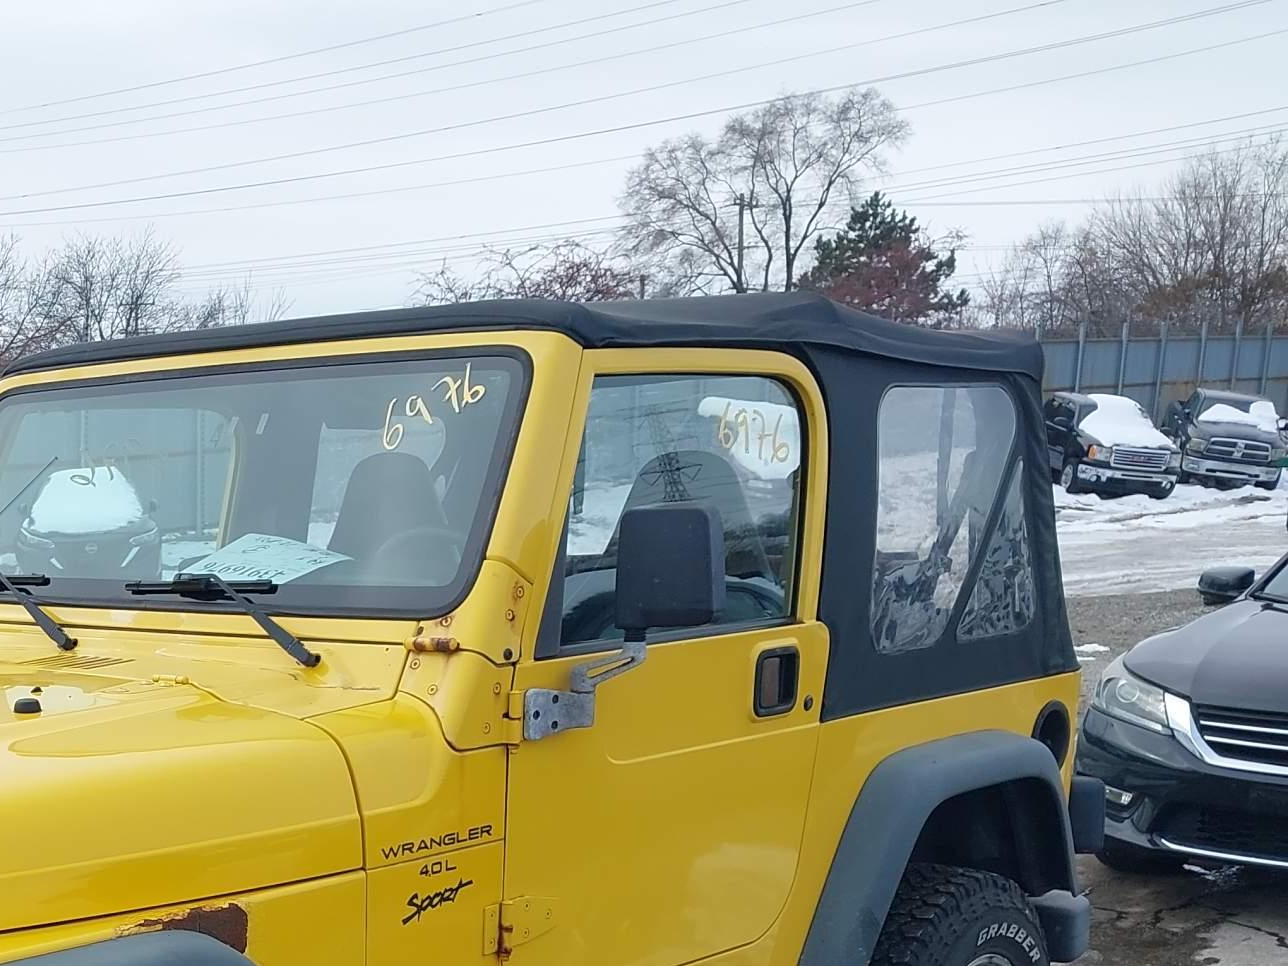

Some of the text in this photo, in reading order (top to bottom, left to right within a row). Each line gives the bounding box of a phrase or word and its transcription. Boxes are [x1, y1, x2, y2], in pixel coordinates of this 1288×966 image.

[718, 401, 790, 463] 6976
[381, 824, 492, 860] WRANGLER
[401, 877, 473, 925] Sport
[976, 922, 1041, 963] GRABBER
